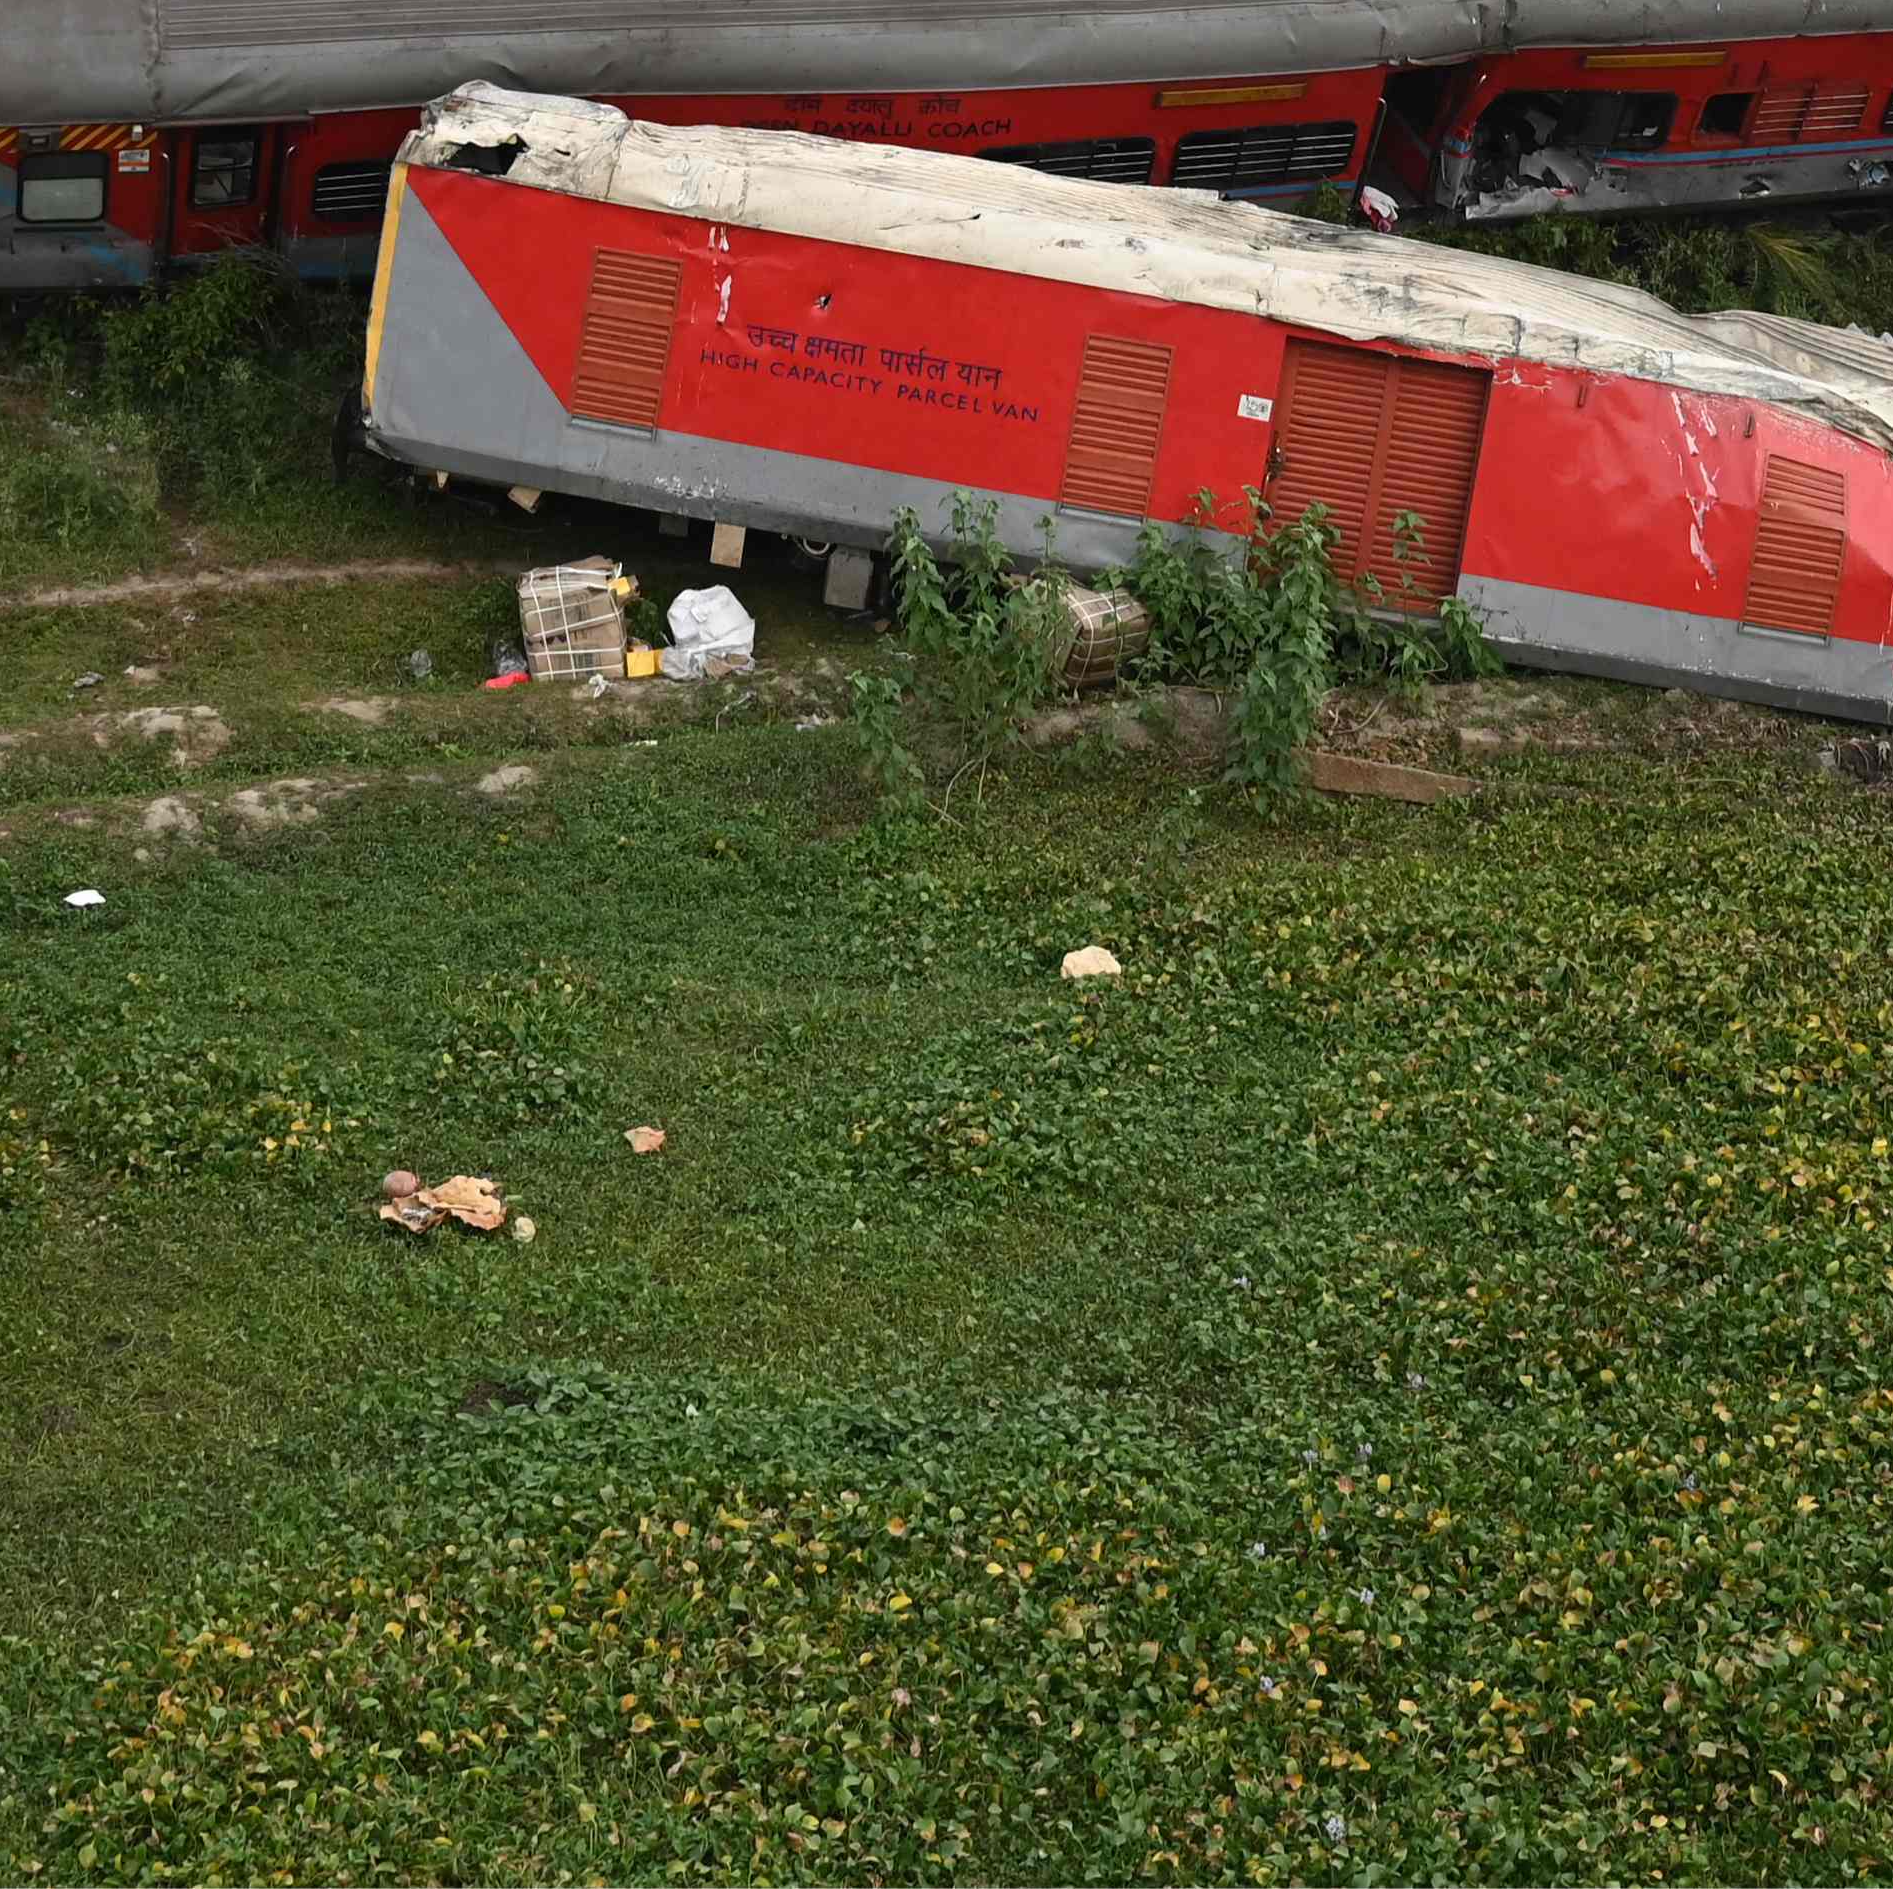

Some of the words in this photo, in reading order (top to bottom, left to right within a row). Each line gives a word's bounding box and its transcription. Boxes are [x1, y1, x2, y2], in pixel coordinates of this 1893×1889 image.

[928, 117, 1012, 138] COACH
[700, 349, 758, 372] HIGH
[770, 361, 883, 396] CAPACITY
[896, 384, 981, 413] PARCEL
[992, 401, 1039, 422] VAN
[747, 324, 798, 356] उच्च
[804, 334, 867, 367] क्षमता
[880, 345, 948, 383] पार्सल
[957, 364, 1003, 390] यान
